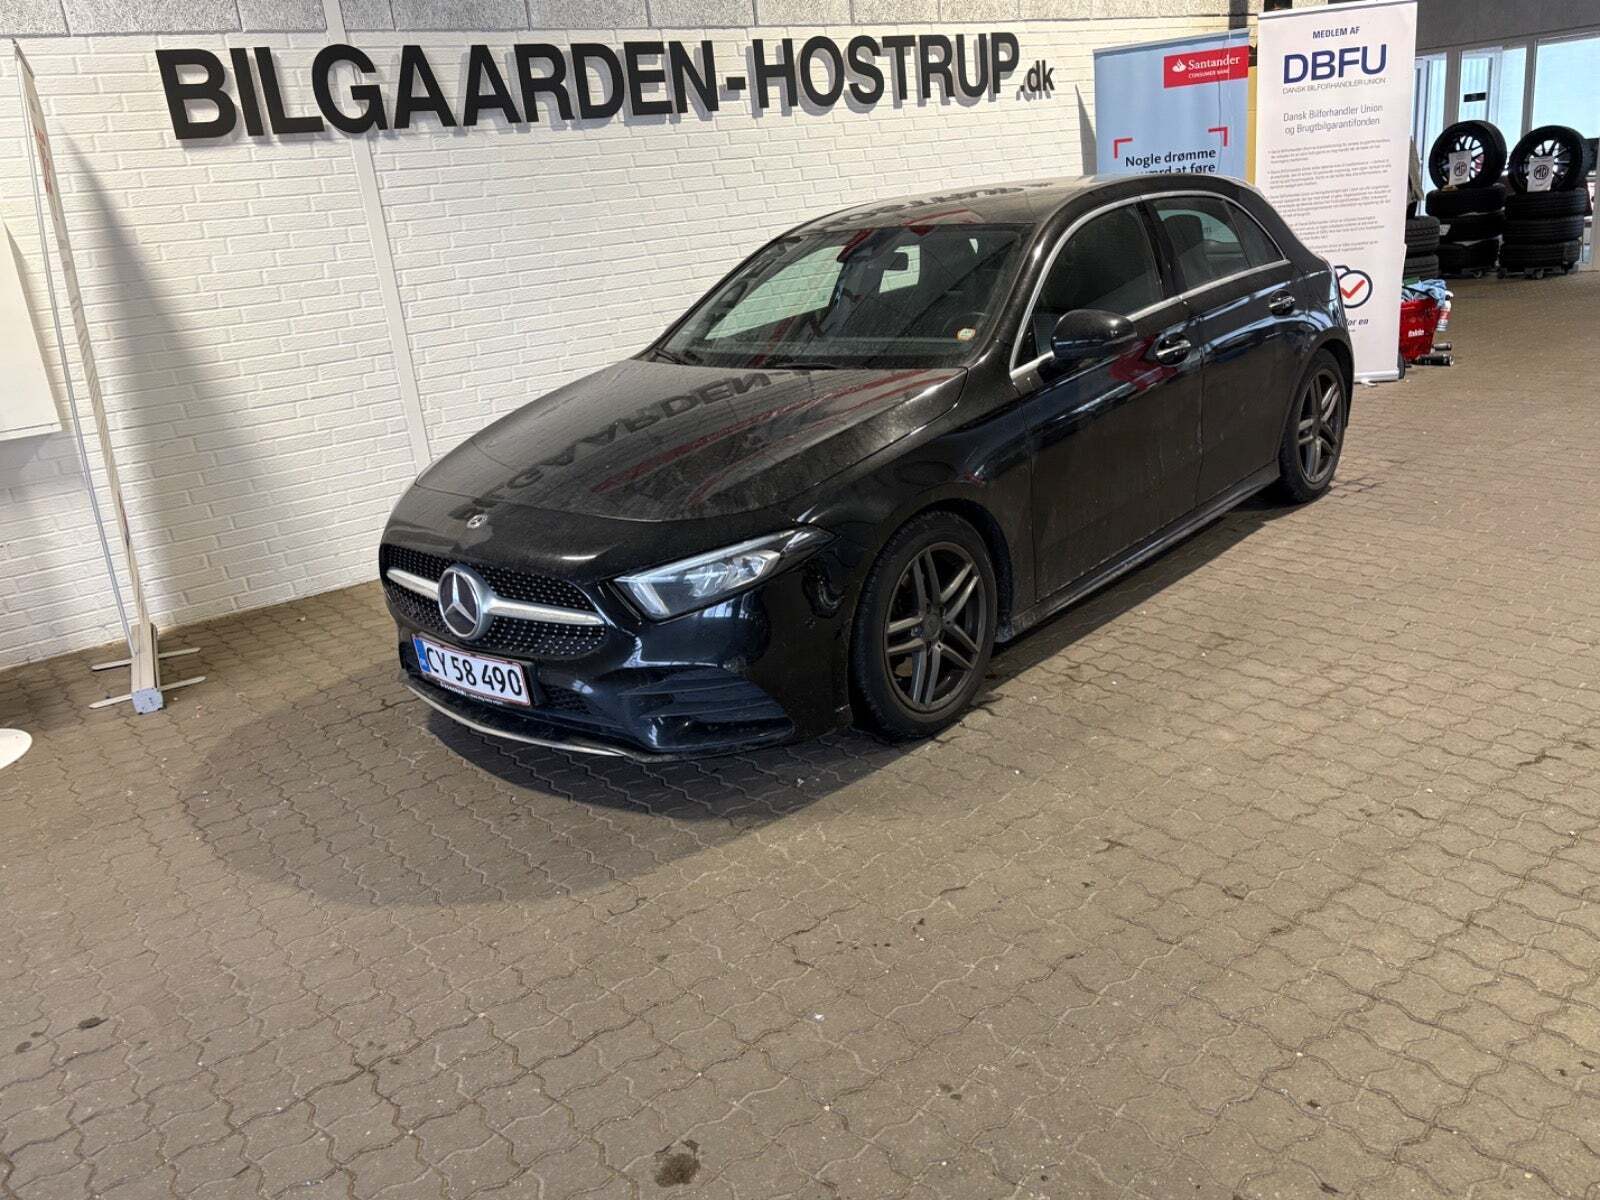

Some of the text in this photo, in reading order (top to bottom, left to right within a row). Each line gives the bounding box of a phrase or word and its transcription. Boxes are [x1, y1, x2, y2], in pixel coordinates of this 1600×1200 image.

[1312, 26, 1361, 39] MEDLEM AF
[1188, 54, 1240, 70] Santander
[1283, 44, 1387, 84] DBFU
[1188, 70, 1216, 79] CONSUMER
[156, 31, 1055, 140] BILGAARDEN-HOSTRUP.dk
[1282, 77, 1387, 95] DANSK BILFORHANDLER UNION
[1283, 104, 1384, 122] Dansk Bilforhandler Union
[1284, 117, 1380, 135] og Brugtbilgarantifonden
[1125, 149, 1217, 168] Nogle drømme
[1174, 166, 1188, 174] at
[1190, 162, 1216, 174] føre
[426, 647, 448, 677] CY
[450, 655, 477, 687] 58
[481, 664, 522, 697] 490
